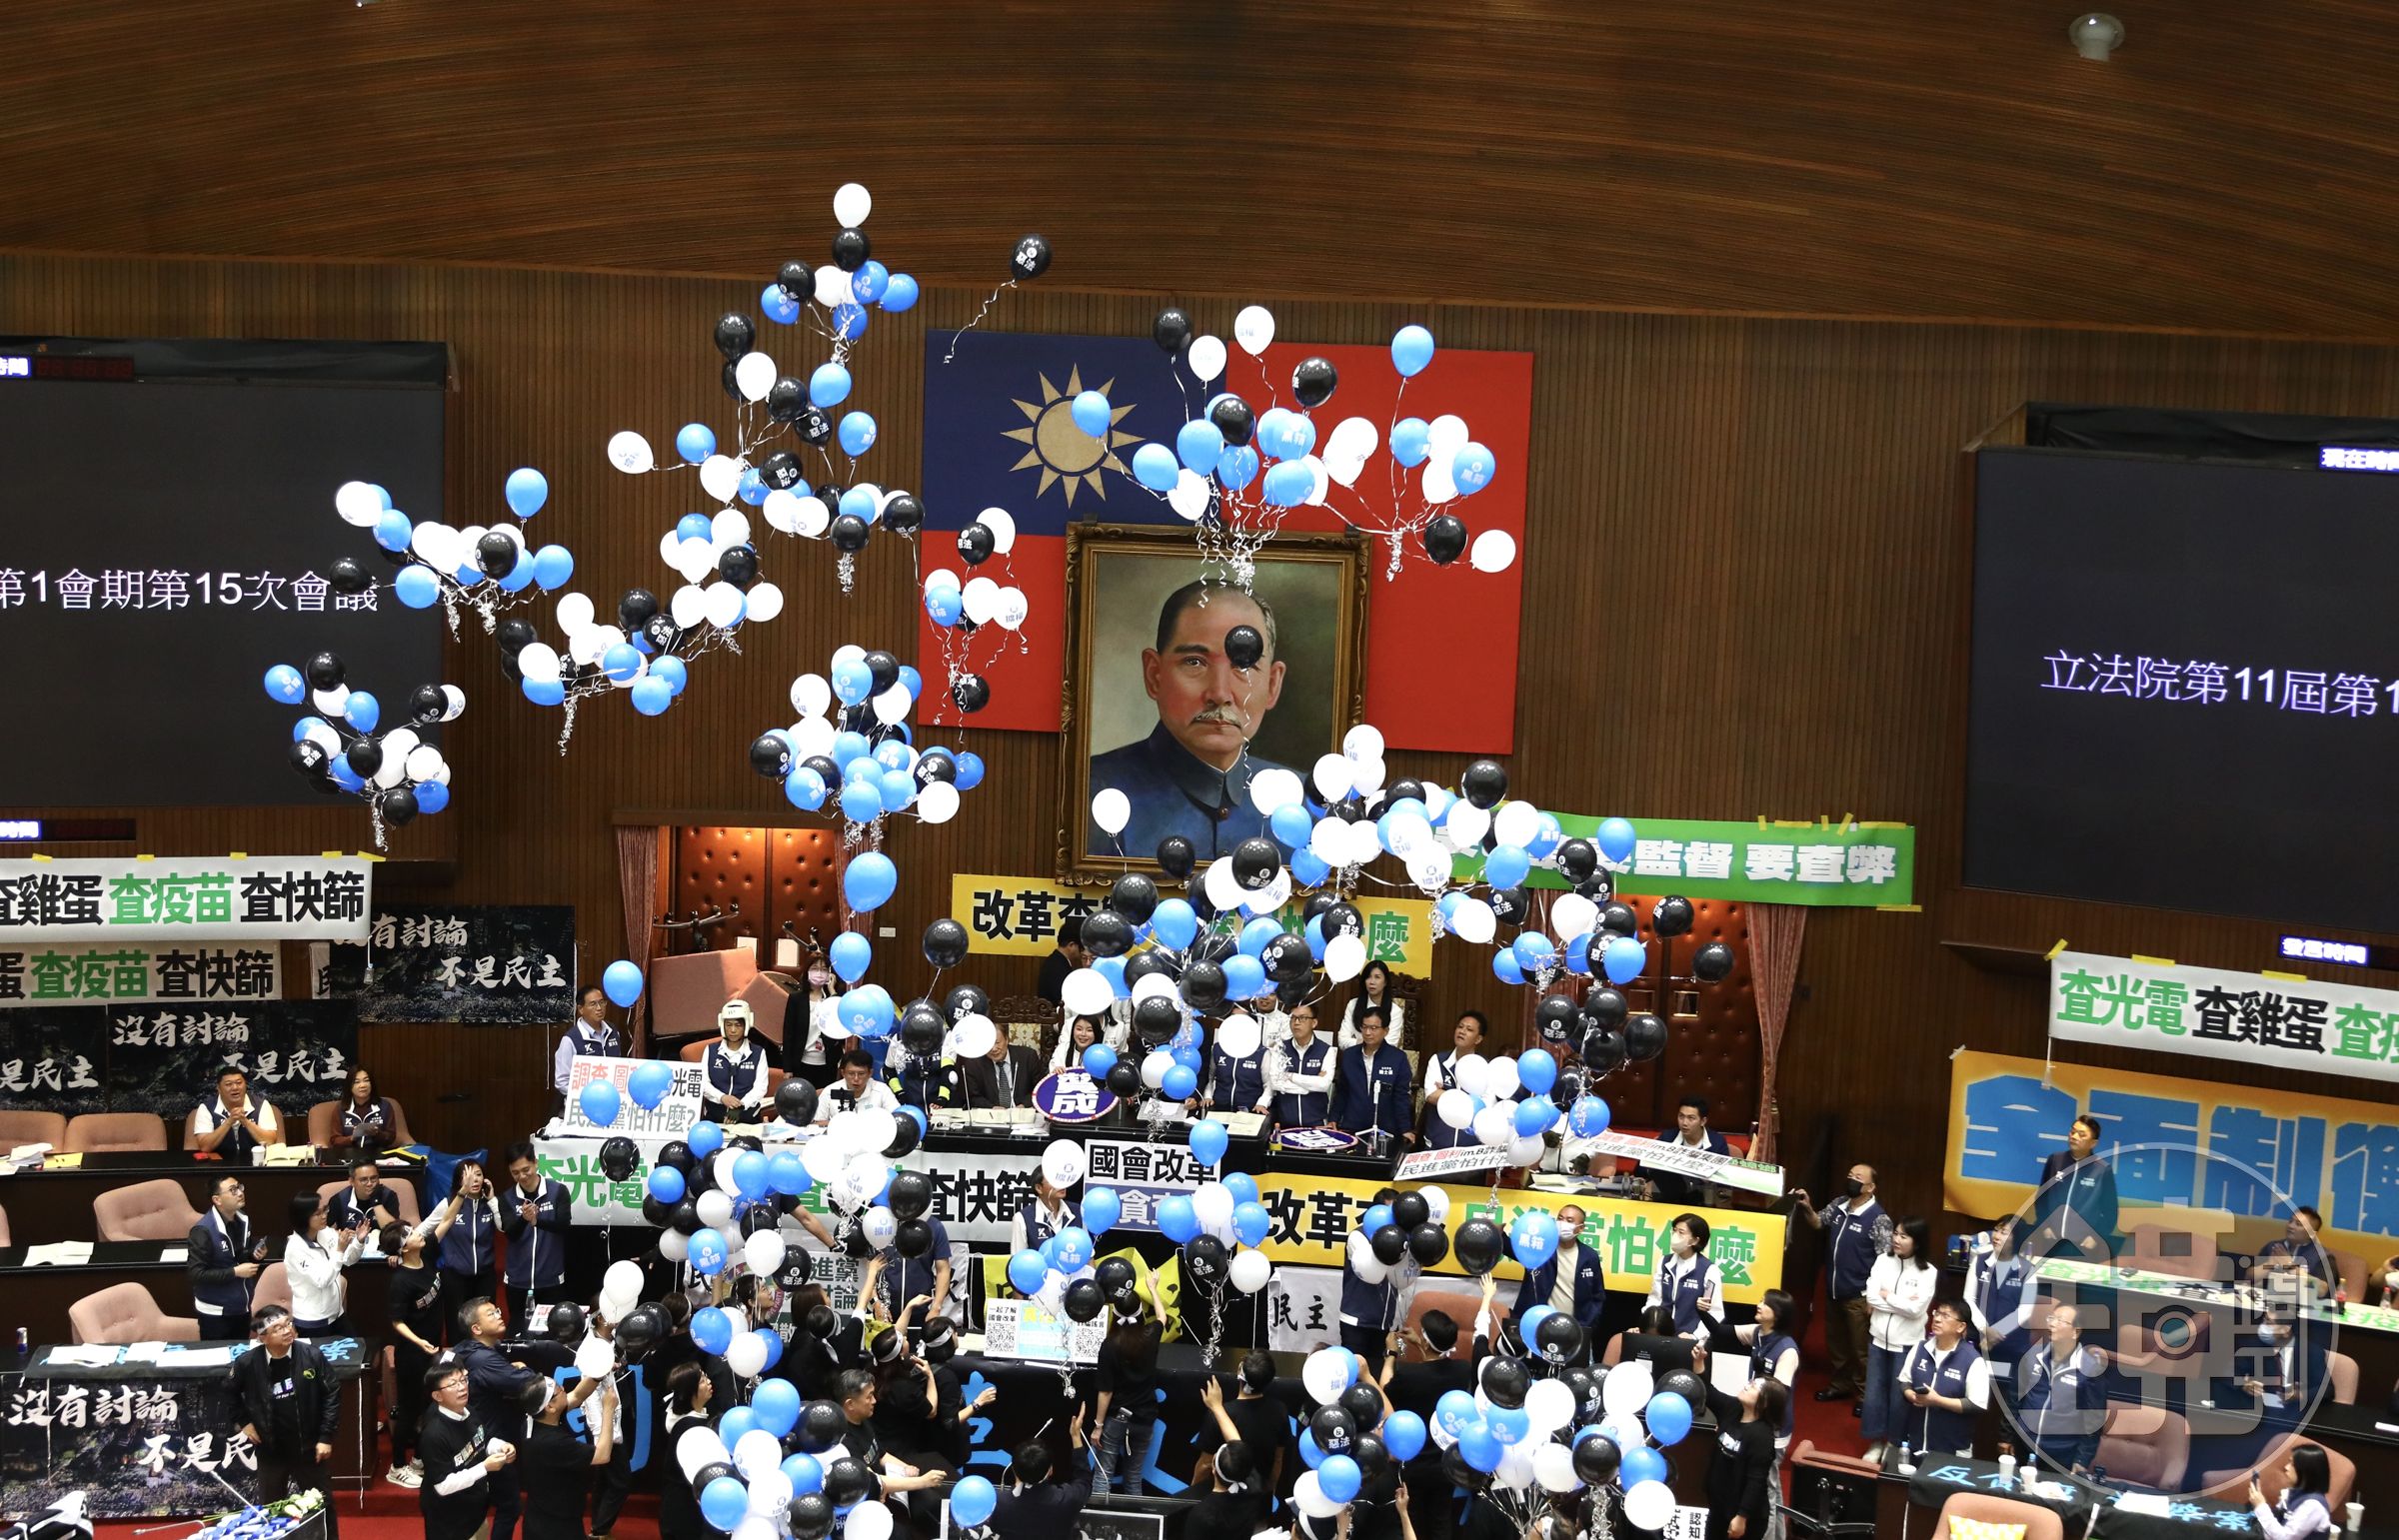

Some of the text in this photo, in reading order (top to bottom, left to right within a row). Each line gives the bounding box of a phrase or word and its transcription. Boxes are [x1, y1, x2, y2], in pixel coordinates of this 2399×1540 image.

[1744, 842, 1897, 884] 要查弊
[109, 871, 234, 925] 查疫苗
[240, 870, 365, 923] 查快篩
[334, 912, 469, 948] 有討論
[30, 949, 150, 999] 查疫苗
[156, 949, 274, 997] 查快篩
[436, 954, 567, 989] 不是民主
[112, 1011, 251, 1047] 沒有討論
[2056, 968, 2189, 1036] 查光電
[2192, 985, 2329, 1055] 查雞蛋
[1543, 1027, 1566, 1039] 惡法
[222, 1047, 349, 1084] 不是民主
[566, 1097, 697, 1134] 民怕什麼?
[1088, 1144, 1217, 1186] 國會改革
[1518, 1233, 1545, 1251] 黑箱
[783, 1275, 804, 1287] 惡法
[1272, 1294, 1329, 1331] 民主
[7, 1384, 181, 1428] 沒有討論
[138, 1432, 260, 1473] 不是民
[1328, 1436, 1351, 1449] 惡法
